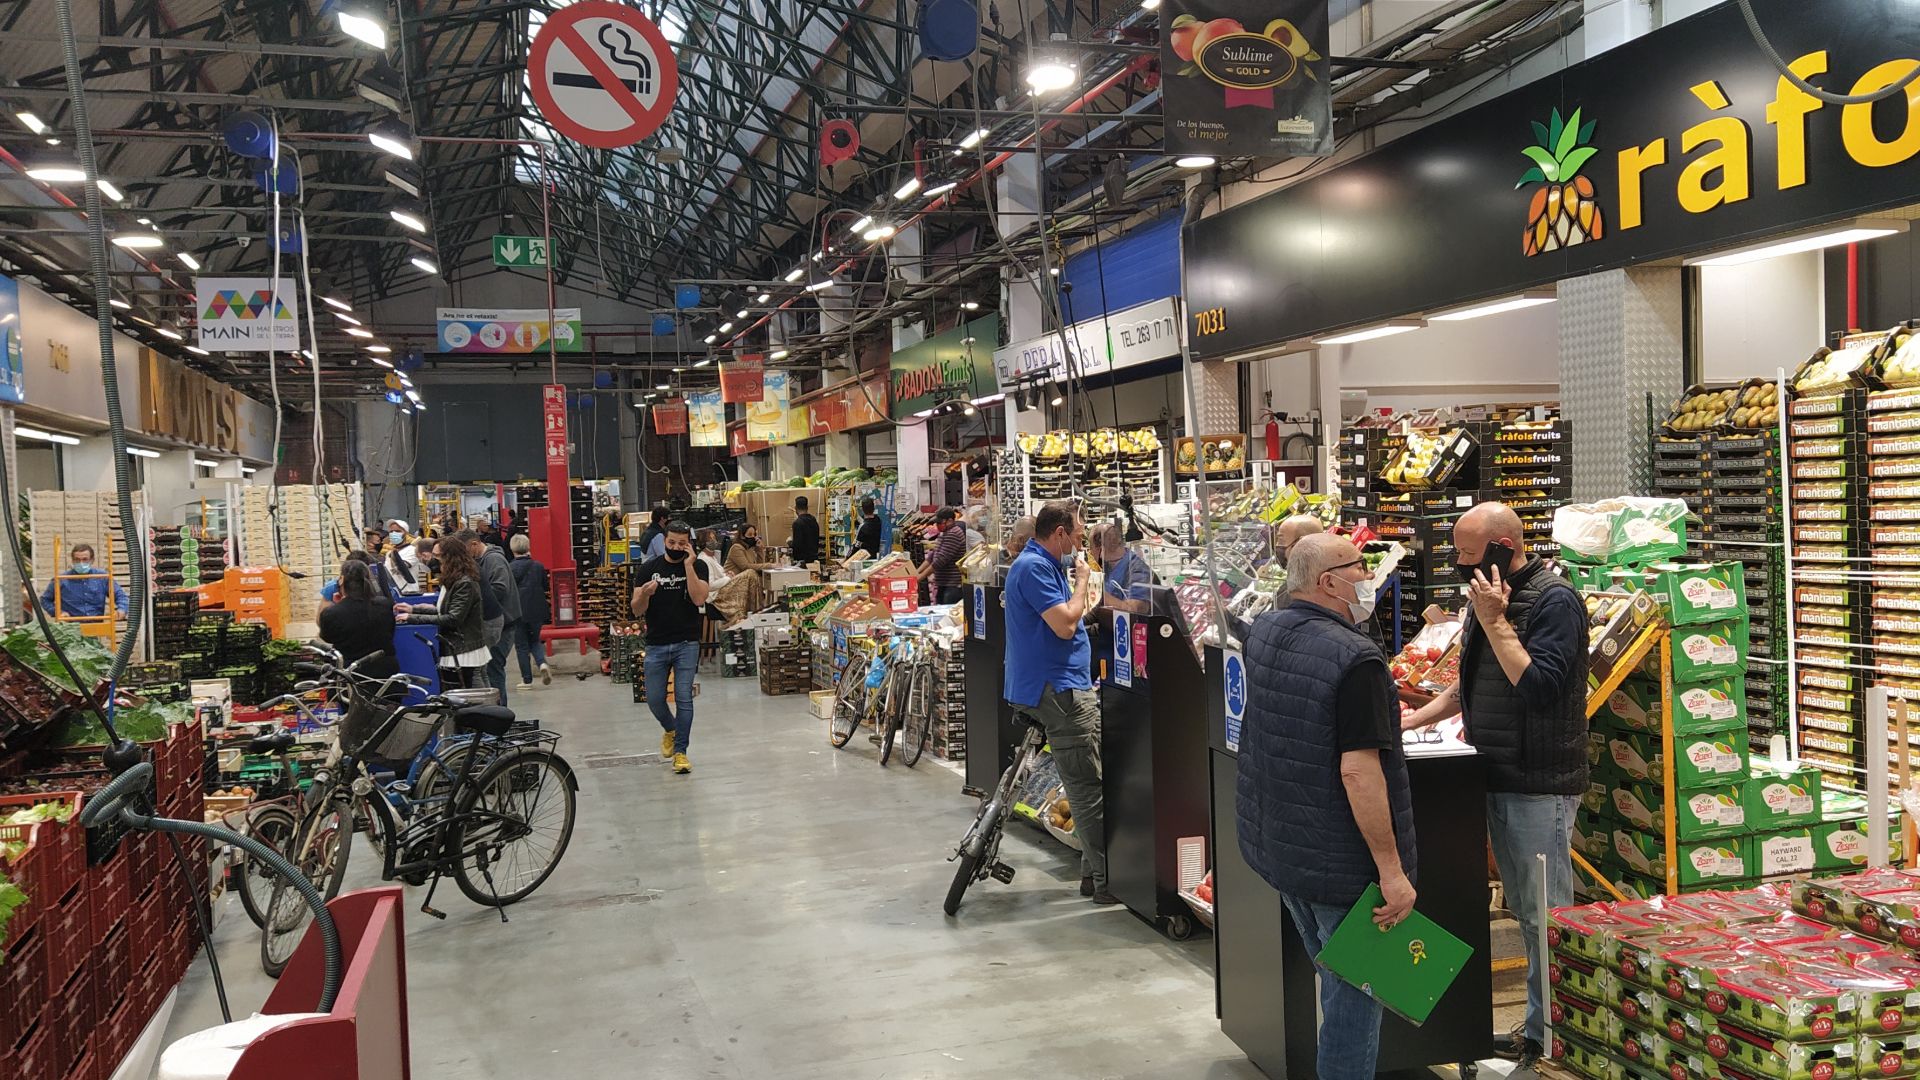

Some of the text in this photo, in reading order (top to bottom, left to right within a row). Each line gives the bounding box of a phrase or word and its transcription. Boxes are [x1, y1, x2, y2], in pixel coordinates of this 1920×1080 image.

[1222, 46, 1273, 62] Sublime
[1236, 66, 1261, 76] GOLD
[1176, 119, 1225, 130] De los buenos,
[1188, 128, 1229, 141] el mejor
[1194, 307, 1226, 337] 7031
[202, 326, 250, 340] MAIN
[1120, 318, 1174, 349] TEL. 263 17 71
[1794, 402, 1836, 414] mantiana
[1794, 423, 1838, 435] mantiana
[1502, 432, 1561, 440] ràfolsfruits
[1502, 454, 1561, 464] ràfolsfruits
[1797, 466, 1840, 477] mantiana
[1502, 476, 1561, 486] ràfolsfruits
[1798, 487, 1841, 498] mantiana
[1380, 504, 1414, 512] ràfolsfruits
[1798, 507, 1841, 518] mantiana
[1382, 526, 1416, 534] ràfolsfruits
[1800, 529, 1842, 540] mantiana
[240, 576, 265, 584] F.GIL
[1688, 587, 1707, 598] Zespri
[1800, 592, 1843, 604] mantiana
[1802, 614, 1844, 625] mantiana
[1688, 644, 1708, 655] Zespri
[1804, 676, 1846, 688] mantiana
[1688, 699, 1707, 708] Zespri
[1803, 695, 1846, 711] mantiana
[1804, 716, 1848, 732] mantiana
[1804, 736, 1848, 752] mantiana
[1694, 752, 1712, 762] Zespri
[1768, 794, 1787, 804] Zespri
[1696, 804, 1714, 814] Zespri
[1770, 846, 1802, 856] HAYWARD
[1836, 842, 1859, 853] Zespri
[1696, 856, 1716, 866] Zespri
